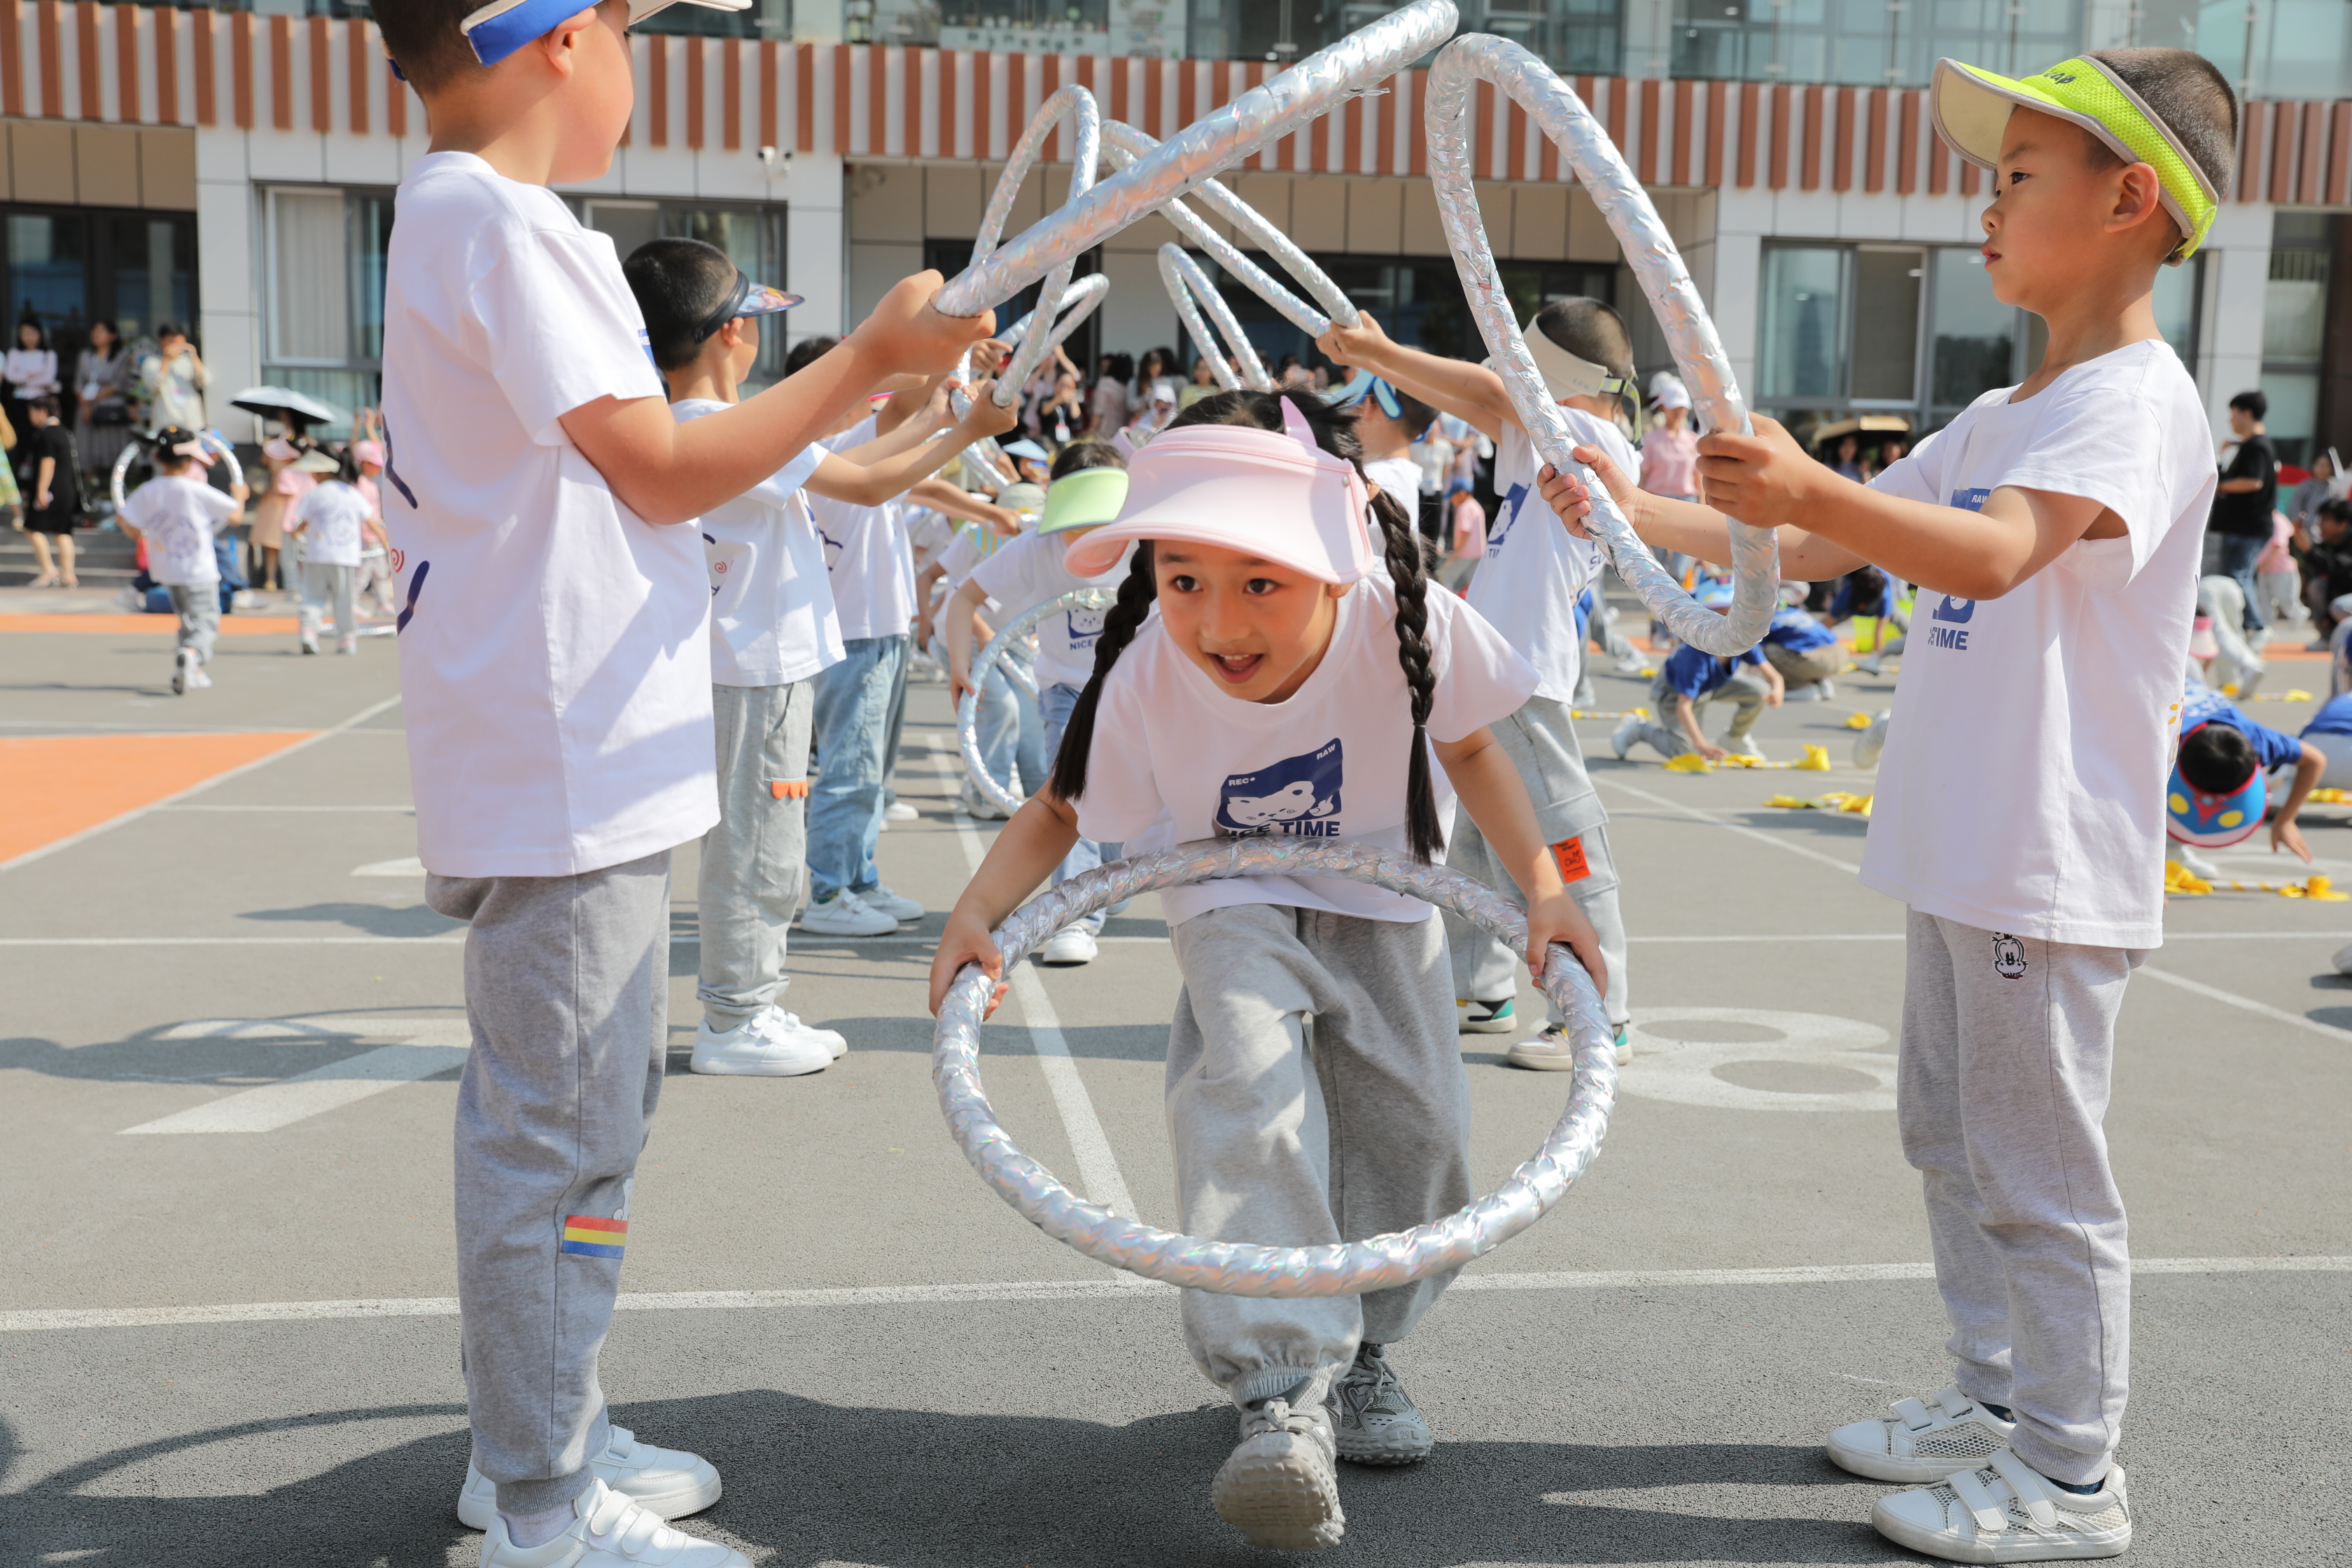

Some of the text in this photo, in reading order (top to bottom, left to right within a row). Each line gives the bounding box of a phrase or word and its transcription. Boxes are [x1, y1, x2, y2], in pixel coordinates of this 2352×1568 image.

[1069, 638, 1093, 651] NICE
[1316, 743, 1336, 760] RAW
[1279, 820, 1340, 837] TIME
[1399, 1429, 1410, 1441] 29
